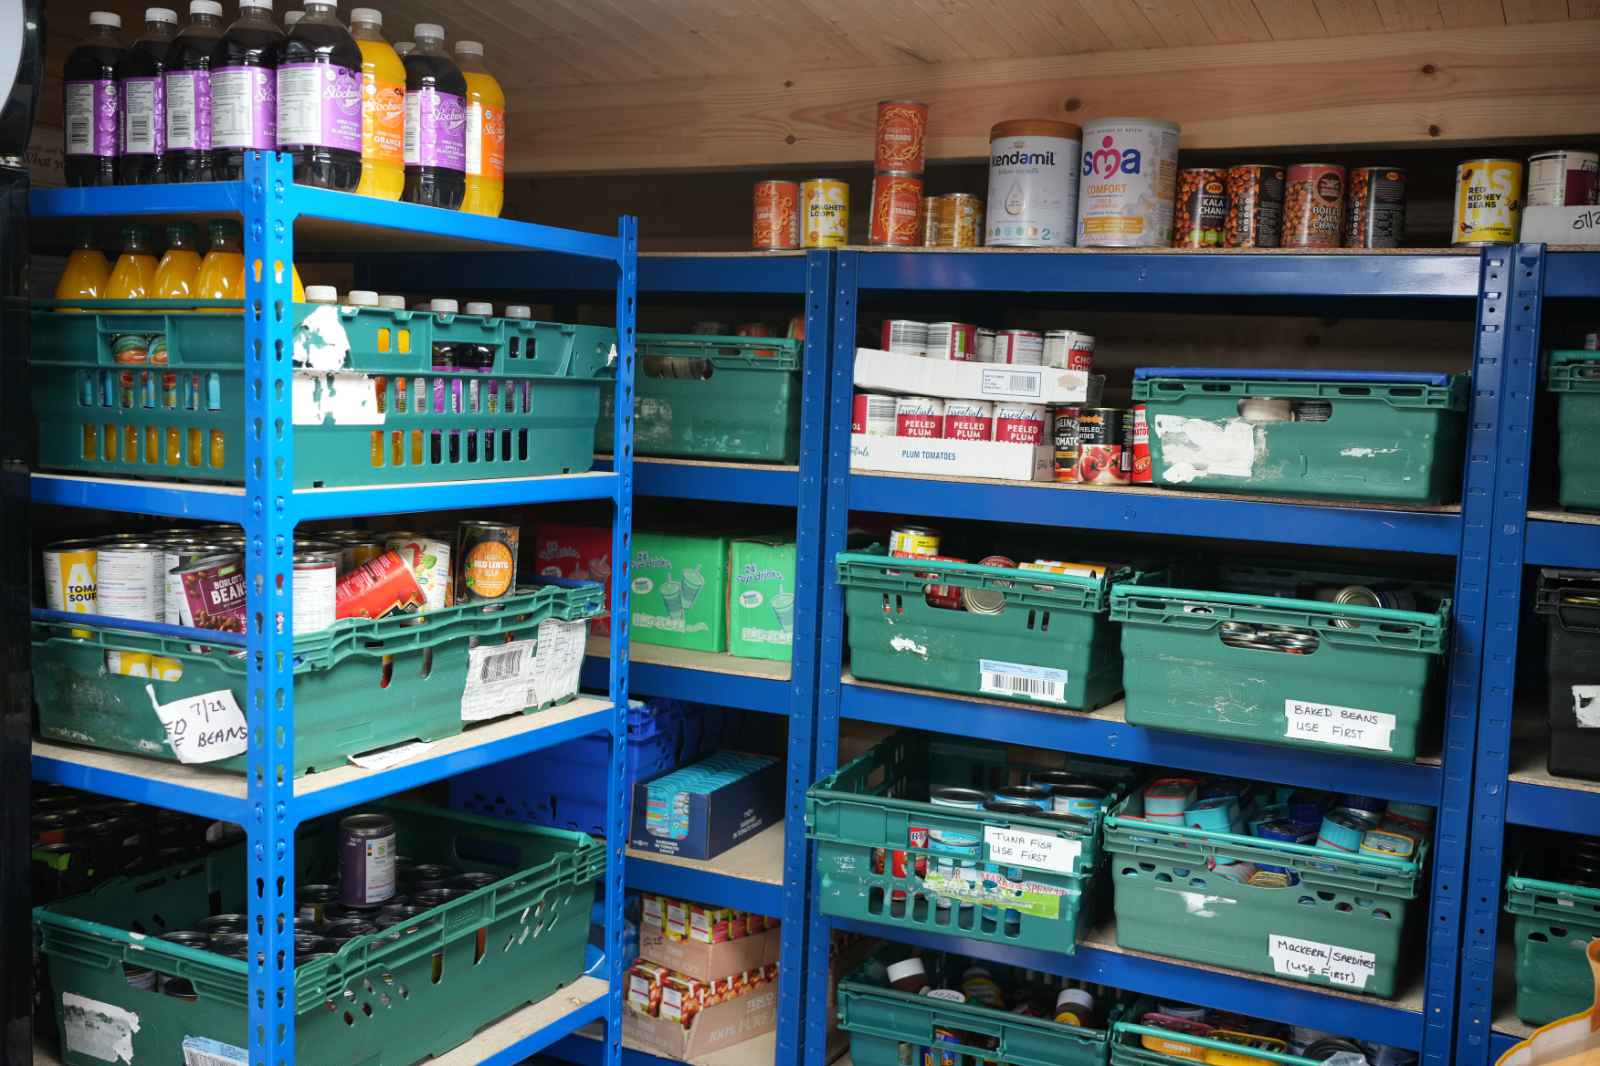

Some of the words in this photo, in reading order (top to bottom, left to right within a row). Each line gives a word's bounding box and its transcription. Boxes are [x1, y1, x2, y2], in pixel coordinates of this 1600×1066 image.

[1468, 186, 1486, 194] RED
[1467, 193, 1502, 201] KIDNEY
[1202, 199, 1224, 208] KALA
[1467, 201, 1497, 209] BEANS
[904, 420, 936, 429] PEELED
[953, 421, 985, 431] PEELED
[1007, 424, 1039, 434] PEELED
[908, 428, 932, 436] PLUM
[956, 429, 981, 438] PLUM
[1010, 432, 1035, 441] PLUM
[1055, 436, 1080, 447] OMATO
[901, 449, 921, 459] PLUM
[921, 450, 956, 461] TOMATOES
[1294, 704, 1333, 718] BAKED
[1340, 709, 1379, 725] BEANS
[1296, 721, 1319, 733] USE
[1332, 725, 1365, 740] FIRST
[197, 725, 248, 748] BEANS
[992, 832, 1025, 845] TUNA
[992, 844, 1013, 856] USE
[1021, 850, 1048, 863] FIRST
